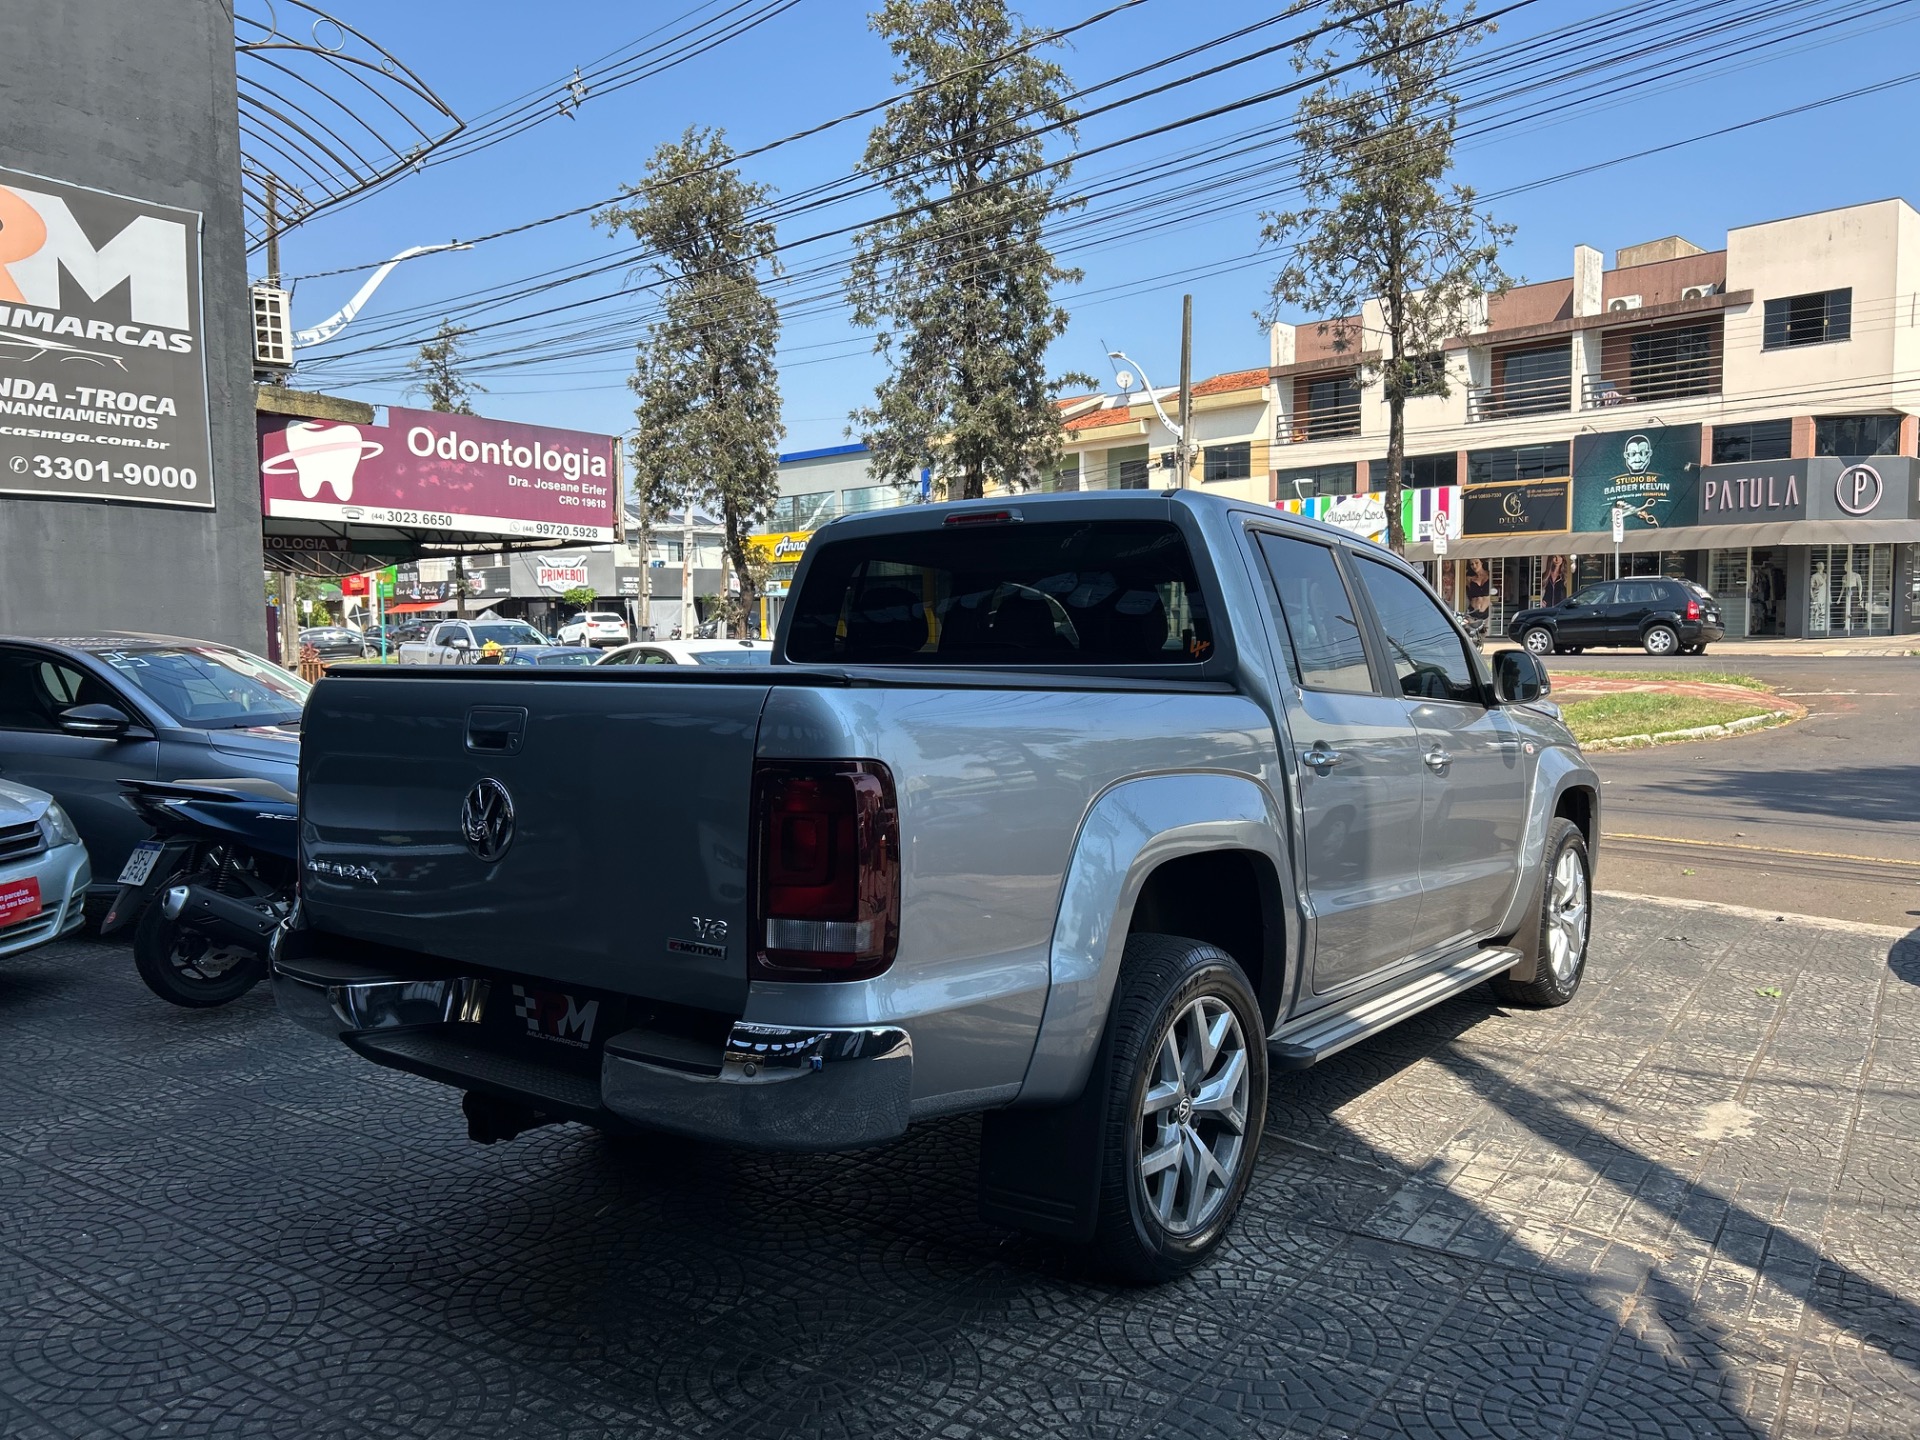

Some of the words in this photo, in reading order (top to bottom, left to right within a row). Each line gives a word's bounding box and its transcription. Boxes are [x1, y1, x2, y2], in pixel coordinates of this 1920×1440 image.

[0, 426, 171, 450] casmga.com.br
[407, 426, 607, 481] Odontologia
[32, 455, 198, 490] 3301-9000
[1615, 476, 1645, 485] STUDIO
[1646, 475, 1658, 483] BK
[508, 475, 532, 488] Dra.
[534, 478, 580, 493] Joseane
[581, 483, 607, 496] Erler
[1604, 484, 1638, 495] BARBER
[1639, 483, 1670, 491] KELVIN
[1704, 475, 1799, 511] PATULA
[1853, 471, 1868, 506] P
[558, 495, 580, 506] CRO
[581, 498, 607, 509] 19618
[371, 513, 385, 521] (44)
[387, 511, 453, 527] 3023.6650
[1364, 509, 1386, 520] Doce
[522, 525, 535, 534] (44)
[536, 524, 599, 538] 99720.5928
[541, 568, 586, 584] PRIMEBOI
[692, 916, 728, 941] V6
[525, 1029, 591, 1050] MULTIMARCAS
